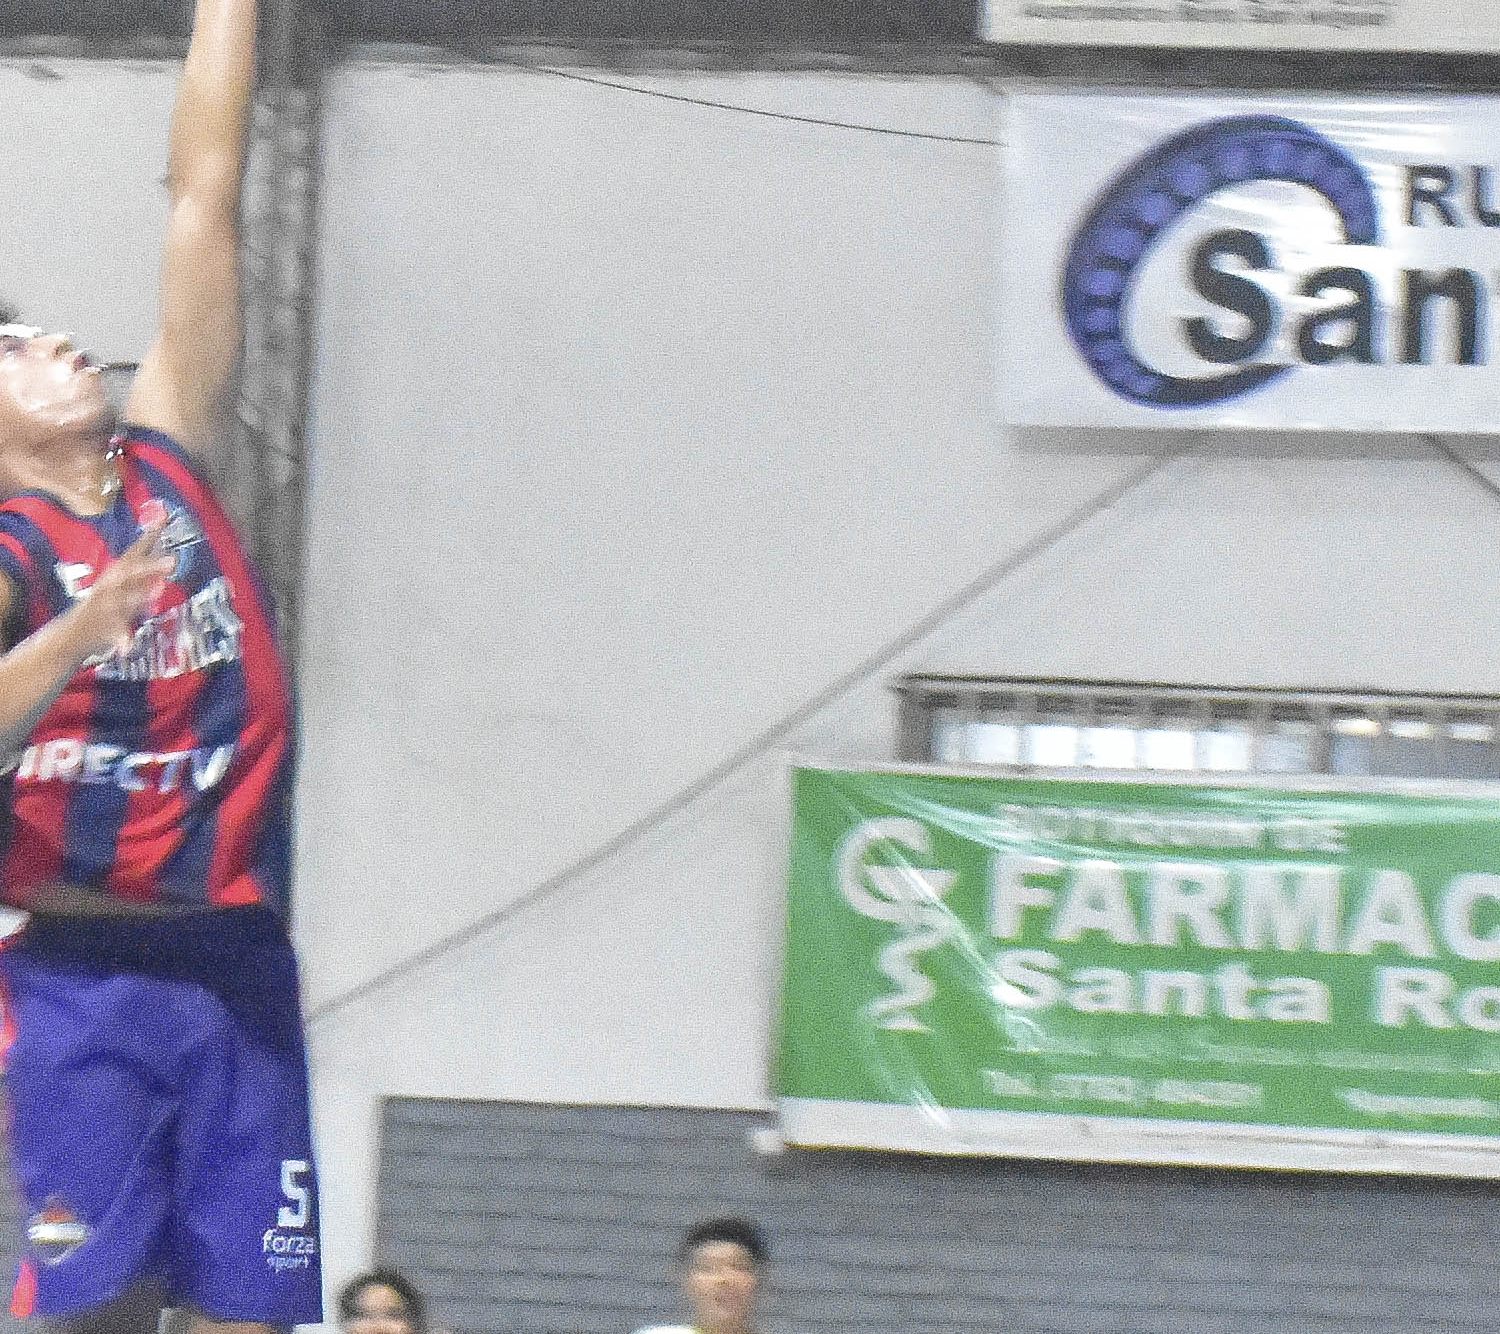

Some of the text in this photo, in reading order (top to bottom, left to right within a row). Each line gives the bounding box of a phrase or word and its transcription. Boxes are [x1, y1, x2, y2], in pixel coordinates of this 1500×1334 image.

[994, 946, 1333, 1025] Santa
[276, 1160, 312, 1228] 5
[262, 1228, 316, 1256] forza
